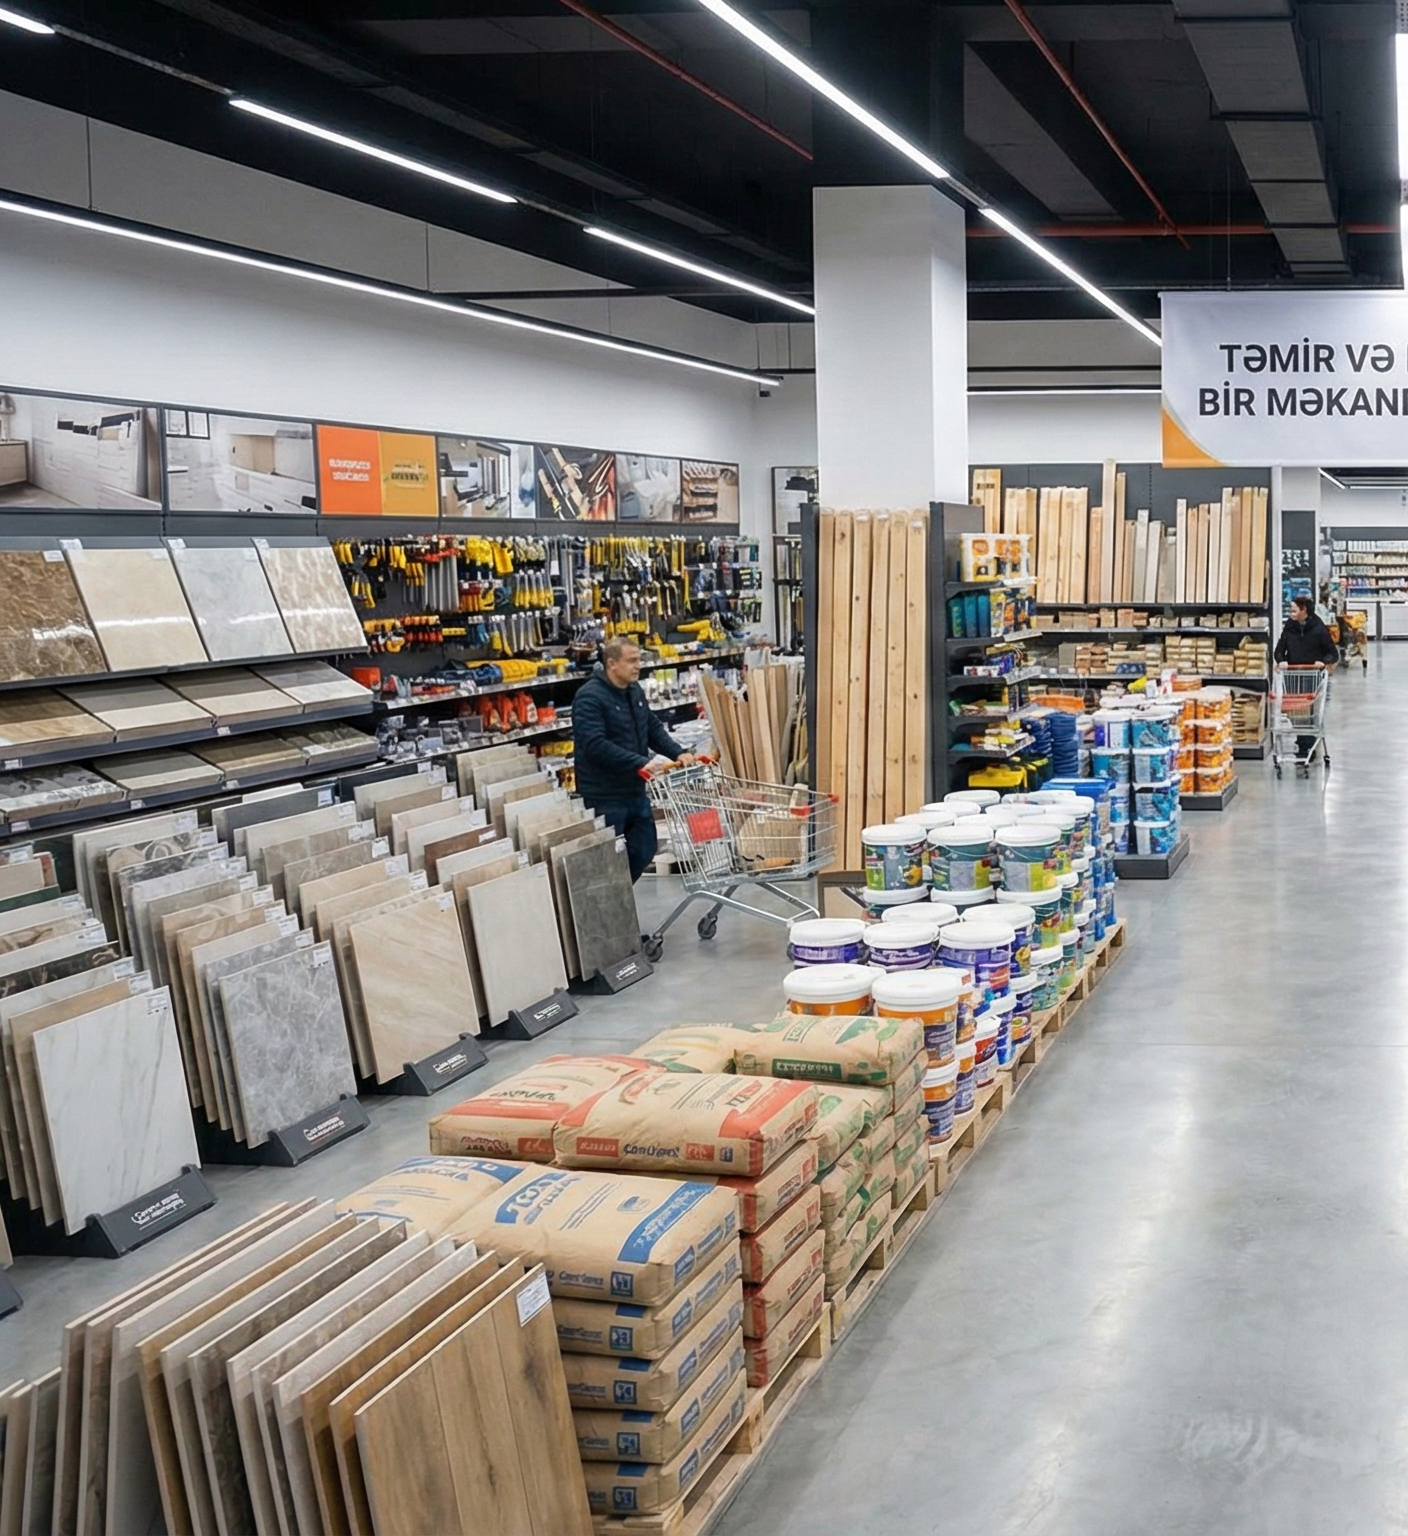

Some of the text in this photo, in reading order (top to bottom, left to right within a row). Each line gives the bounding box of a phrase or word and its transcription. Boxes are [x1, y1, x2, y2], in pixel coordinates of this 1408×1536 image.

[1219, 337, 1335, 373] TƏMİR
[1345, 344, 1395, 373] VƏ
[1199, 380, 1256, 416] BİR
